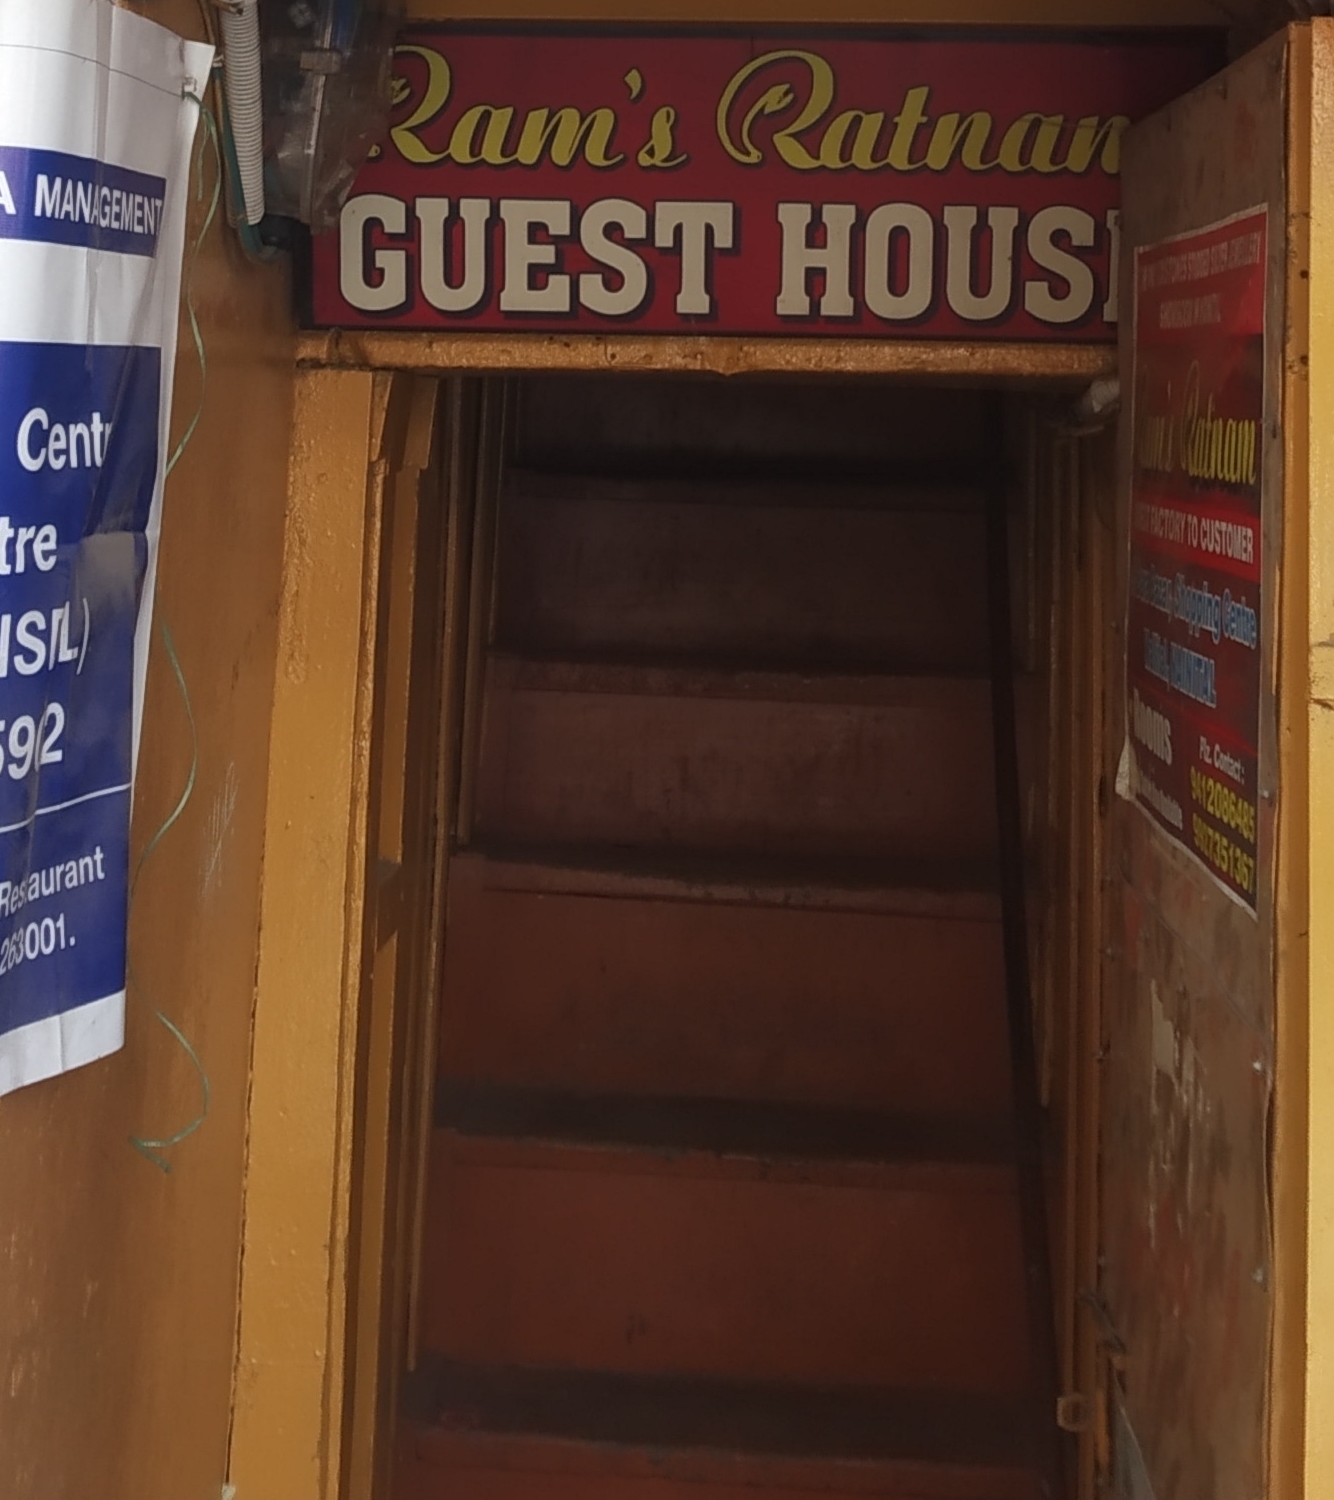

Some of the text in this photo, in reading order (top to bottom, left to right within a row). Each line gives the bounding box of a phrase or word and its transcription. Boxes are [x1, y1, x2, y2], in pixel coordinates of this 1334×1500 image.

[367, 45, 688, 169] Ram's
[34, 174, 162, 235] MANAGEMENT
[339, 195, 1120, 324] GUEST HOUS
[1200, 517, 1254, 564] CUSTOMER
[1222, 587, 1258, 650] Centre
